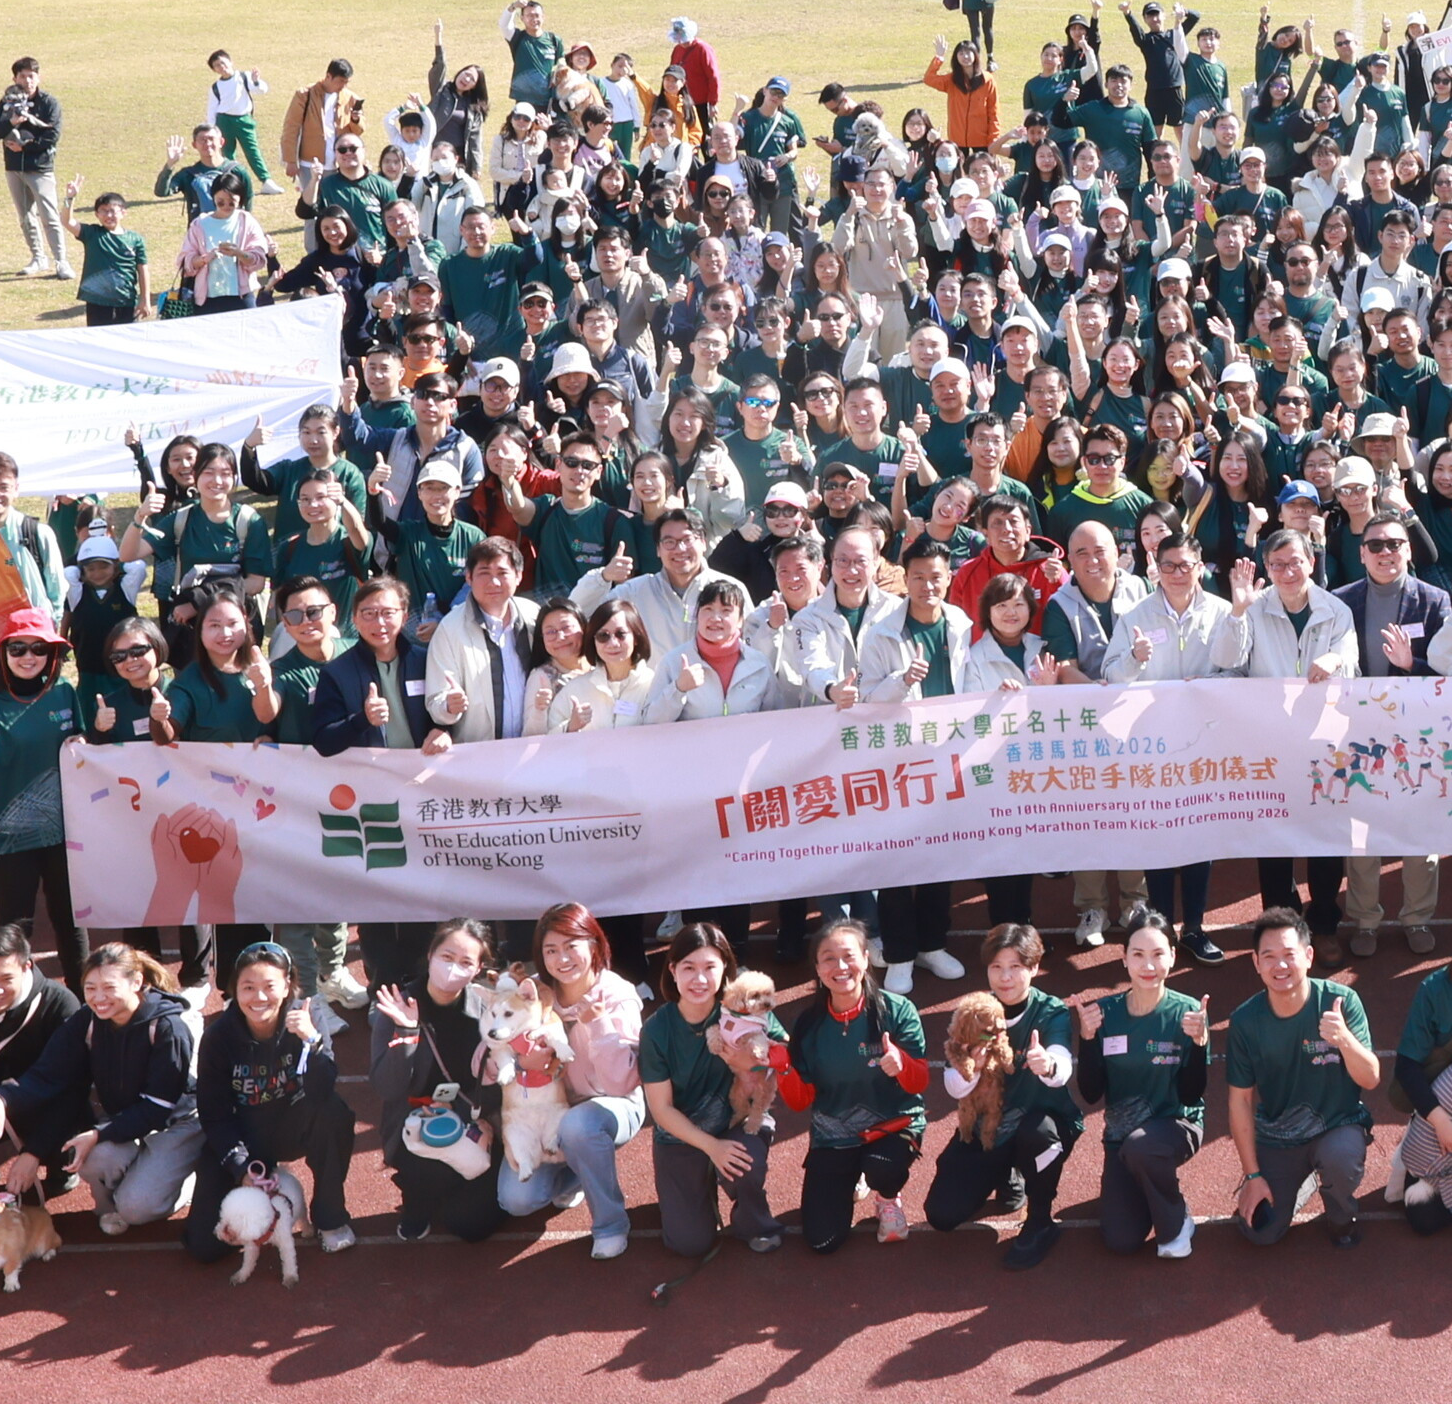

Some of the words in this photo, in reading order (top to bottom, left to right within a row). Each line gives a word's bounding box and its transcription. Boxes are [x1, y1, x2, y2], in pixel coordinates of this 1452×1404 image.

[840, 707, 1099, 751] 香港教育大學正名十年
[1005, 736, 1167, 763] 香港馬拉松2026
[416, 794, 563, 822] 香港教育大學
[989, 805, 1014, 818] The
[1017, 803, 1046, 816] 10th
[1049, 798, 1130, 815] Anniversary
[1132, 797, 1148, 811] of
[1150, 796, 1172, 810] the
[1228, 788, 1286, 805] Retitling
[419, 832, 453, 848] The
[458, 828, 546, 848] Education
[548, 823, 643, 844] University
[779, 843, 839, 860] Together
[925, 832, 949, 845] and
[953, 827, 985, 842] Hong
[989, 823, 1022, 838] Kong
[1025, 817, 1090, 834] Marathon
[1093, 817, 1127, 831] Team
[1130, 814, 1186, 831] Kick-off
[1188, 809, 1254, 827] Ceremony
[1257, 807, 1290, 820] 2026
[423, 852, 442, 867] of
[444, 852, 493, 870] Hong
[497, 851, 544, 870] Kong
